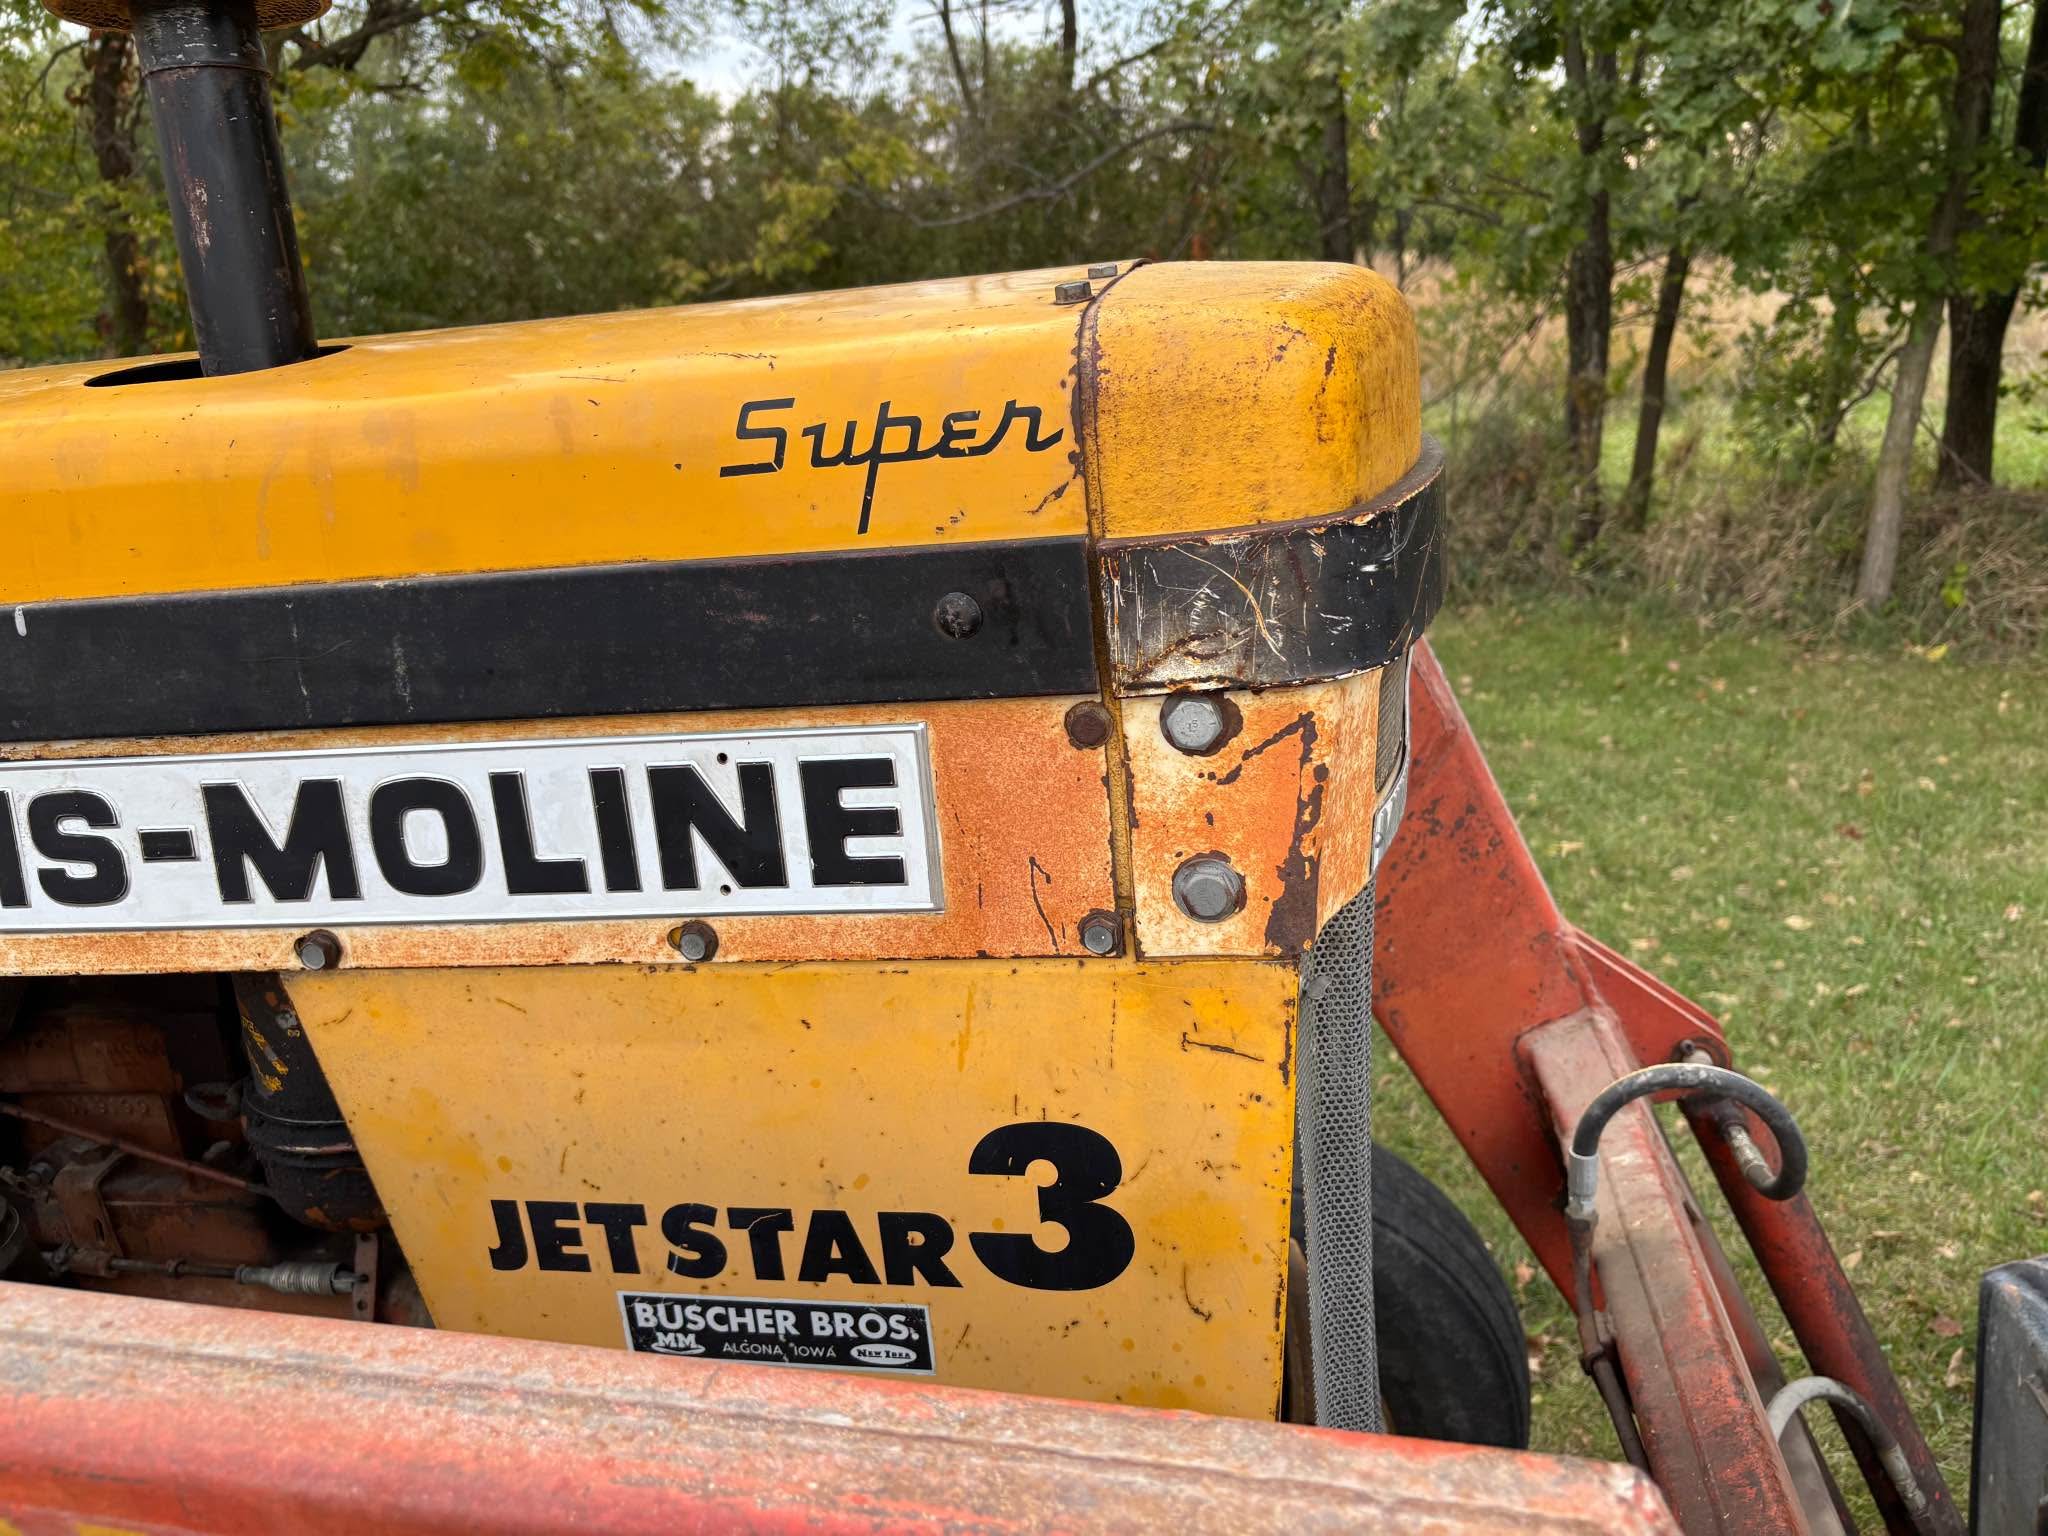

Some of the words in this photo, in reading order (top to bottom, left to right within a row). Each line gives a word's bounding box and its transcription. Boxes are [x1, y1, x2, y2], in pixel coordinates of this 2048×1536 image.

[720, 397, 1064, 535] Super
[968, 1121, 1135, 1291] 3
[635, 1301, 800, 1336] BUSCHER
[810, 1311, 919, 1341] BROS.
[656, 1331, 698, 1349] MM
[794, 1345, 837, 1358] IOWA
